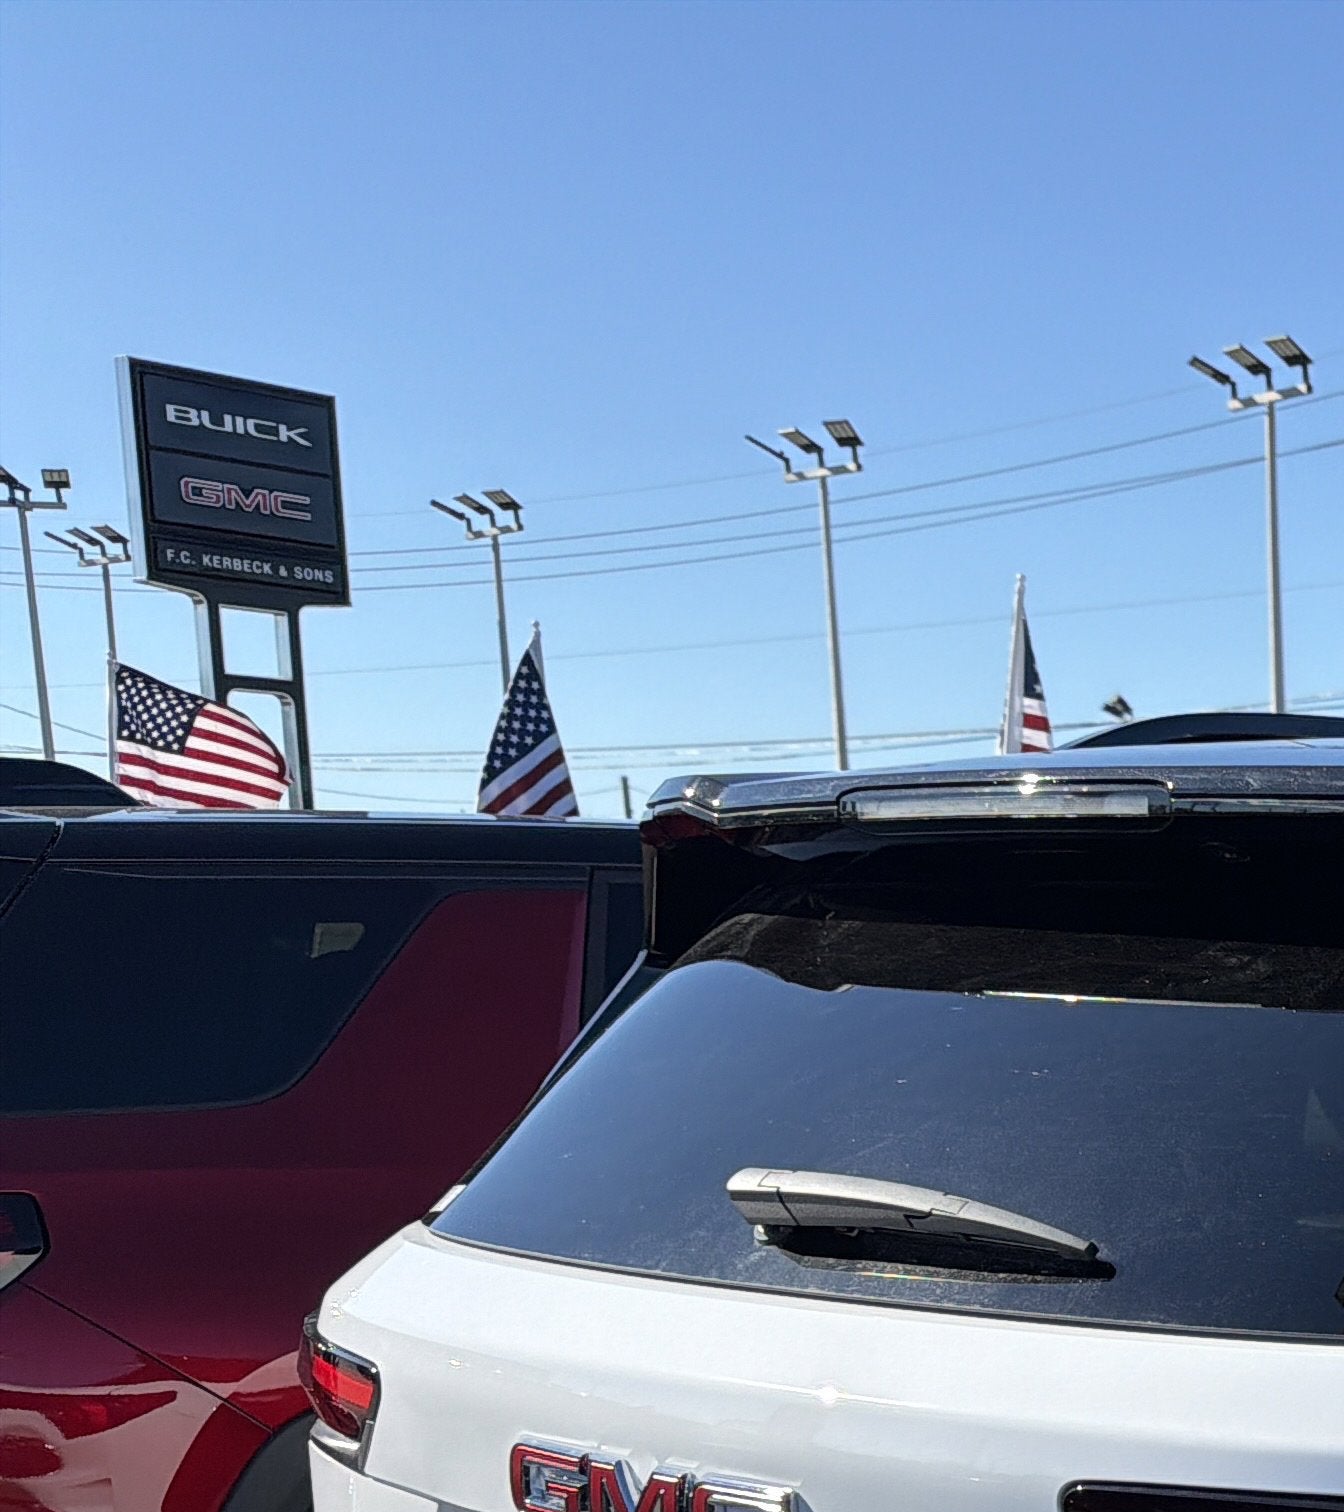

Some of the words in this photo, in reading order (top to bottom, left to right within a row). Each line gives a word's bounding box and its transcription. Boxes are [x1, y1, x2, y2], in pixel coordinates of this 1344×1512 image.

[165, 403, 313, 448] BUICK
[179, 476, 312, 521] GMC
[165, 548, 196, 566] F.C.
[202, 554, 273, 576] KERBECK
[278, 565, 288, 577] &
[293, 567, 334, 584] SONS
